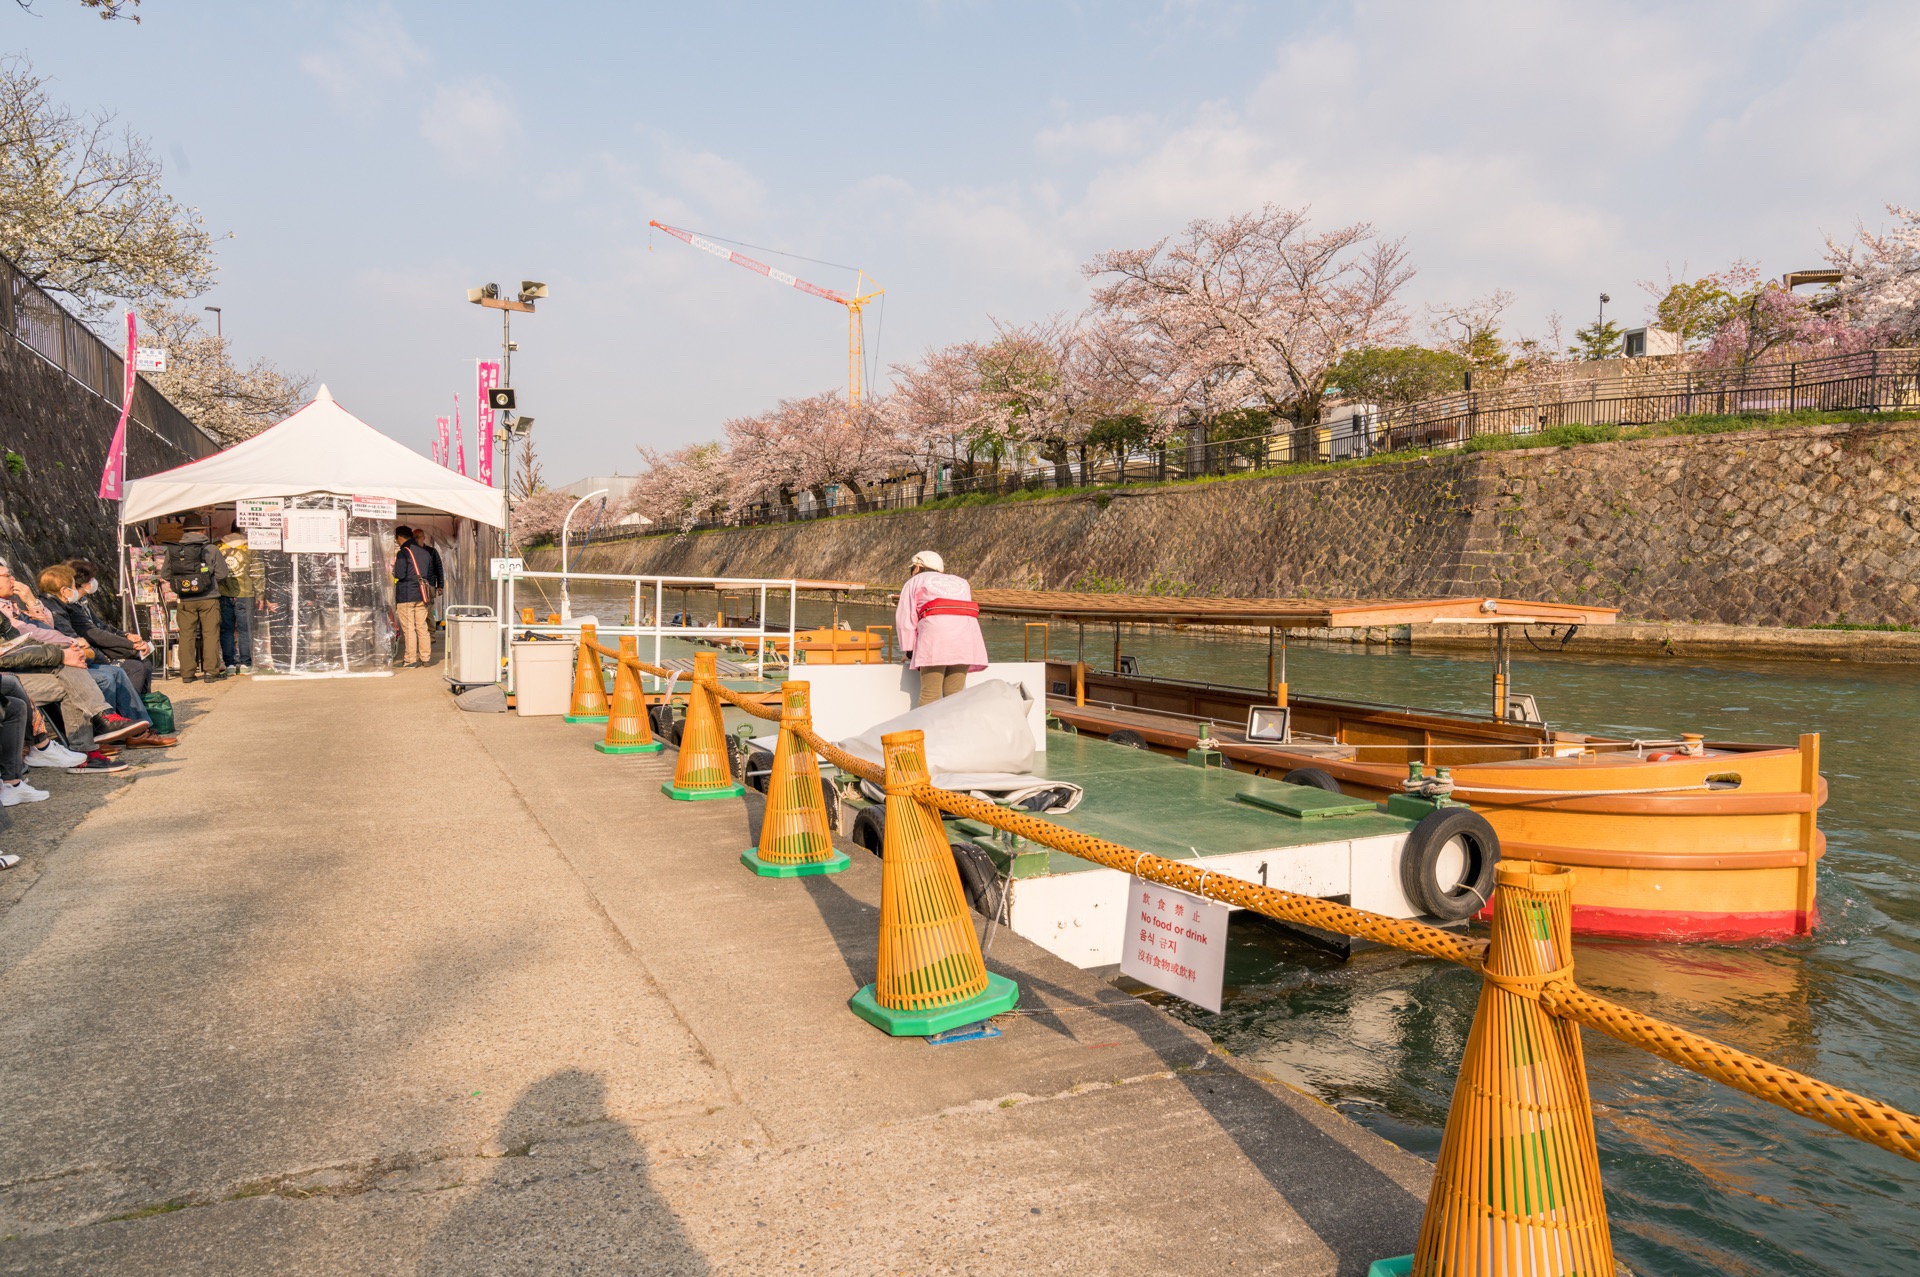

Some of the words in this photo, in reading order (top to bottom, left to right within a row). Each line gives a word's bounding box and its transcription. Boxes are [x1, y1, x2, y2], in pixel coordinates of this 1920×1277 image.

[1257, 862, 1268, 887] 1
[1143, 892, 1200, 923] 飲食禁止
[1141, 911, 1151, 924] No
[1153, 917, 1172, 931] food
[1174, 925, 1184, 936] or
[1186, 929, 1207, 944] drink
[1158, 937, 1177, 954] 금지
